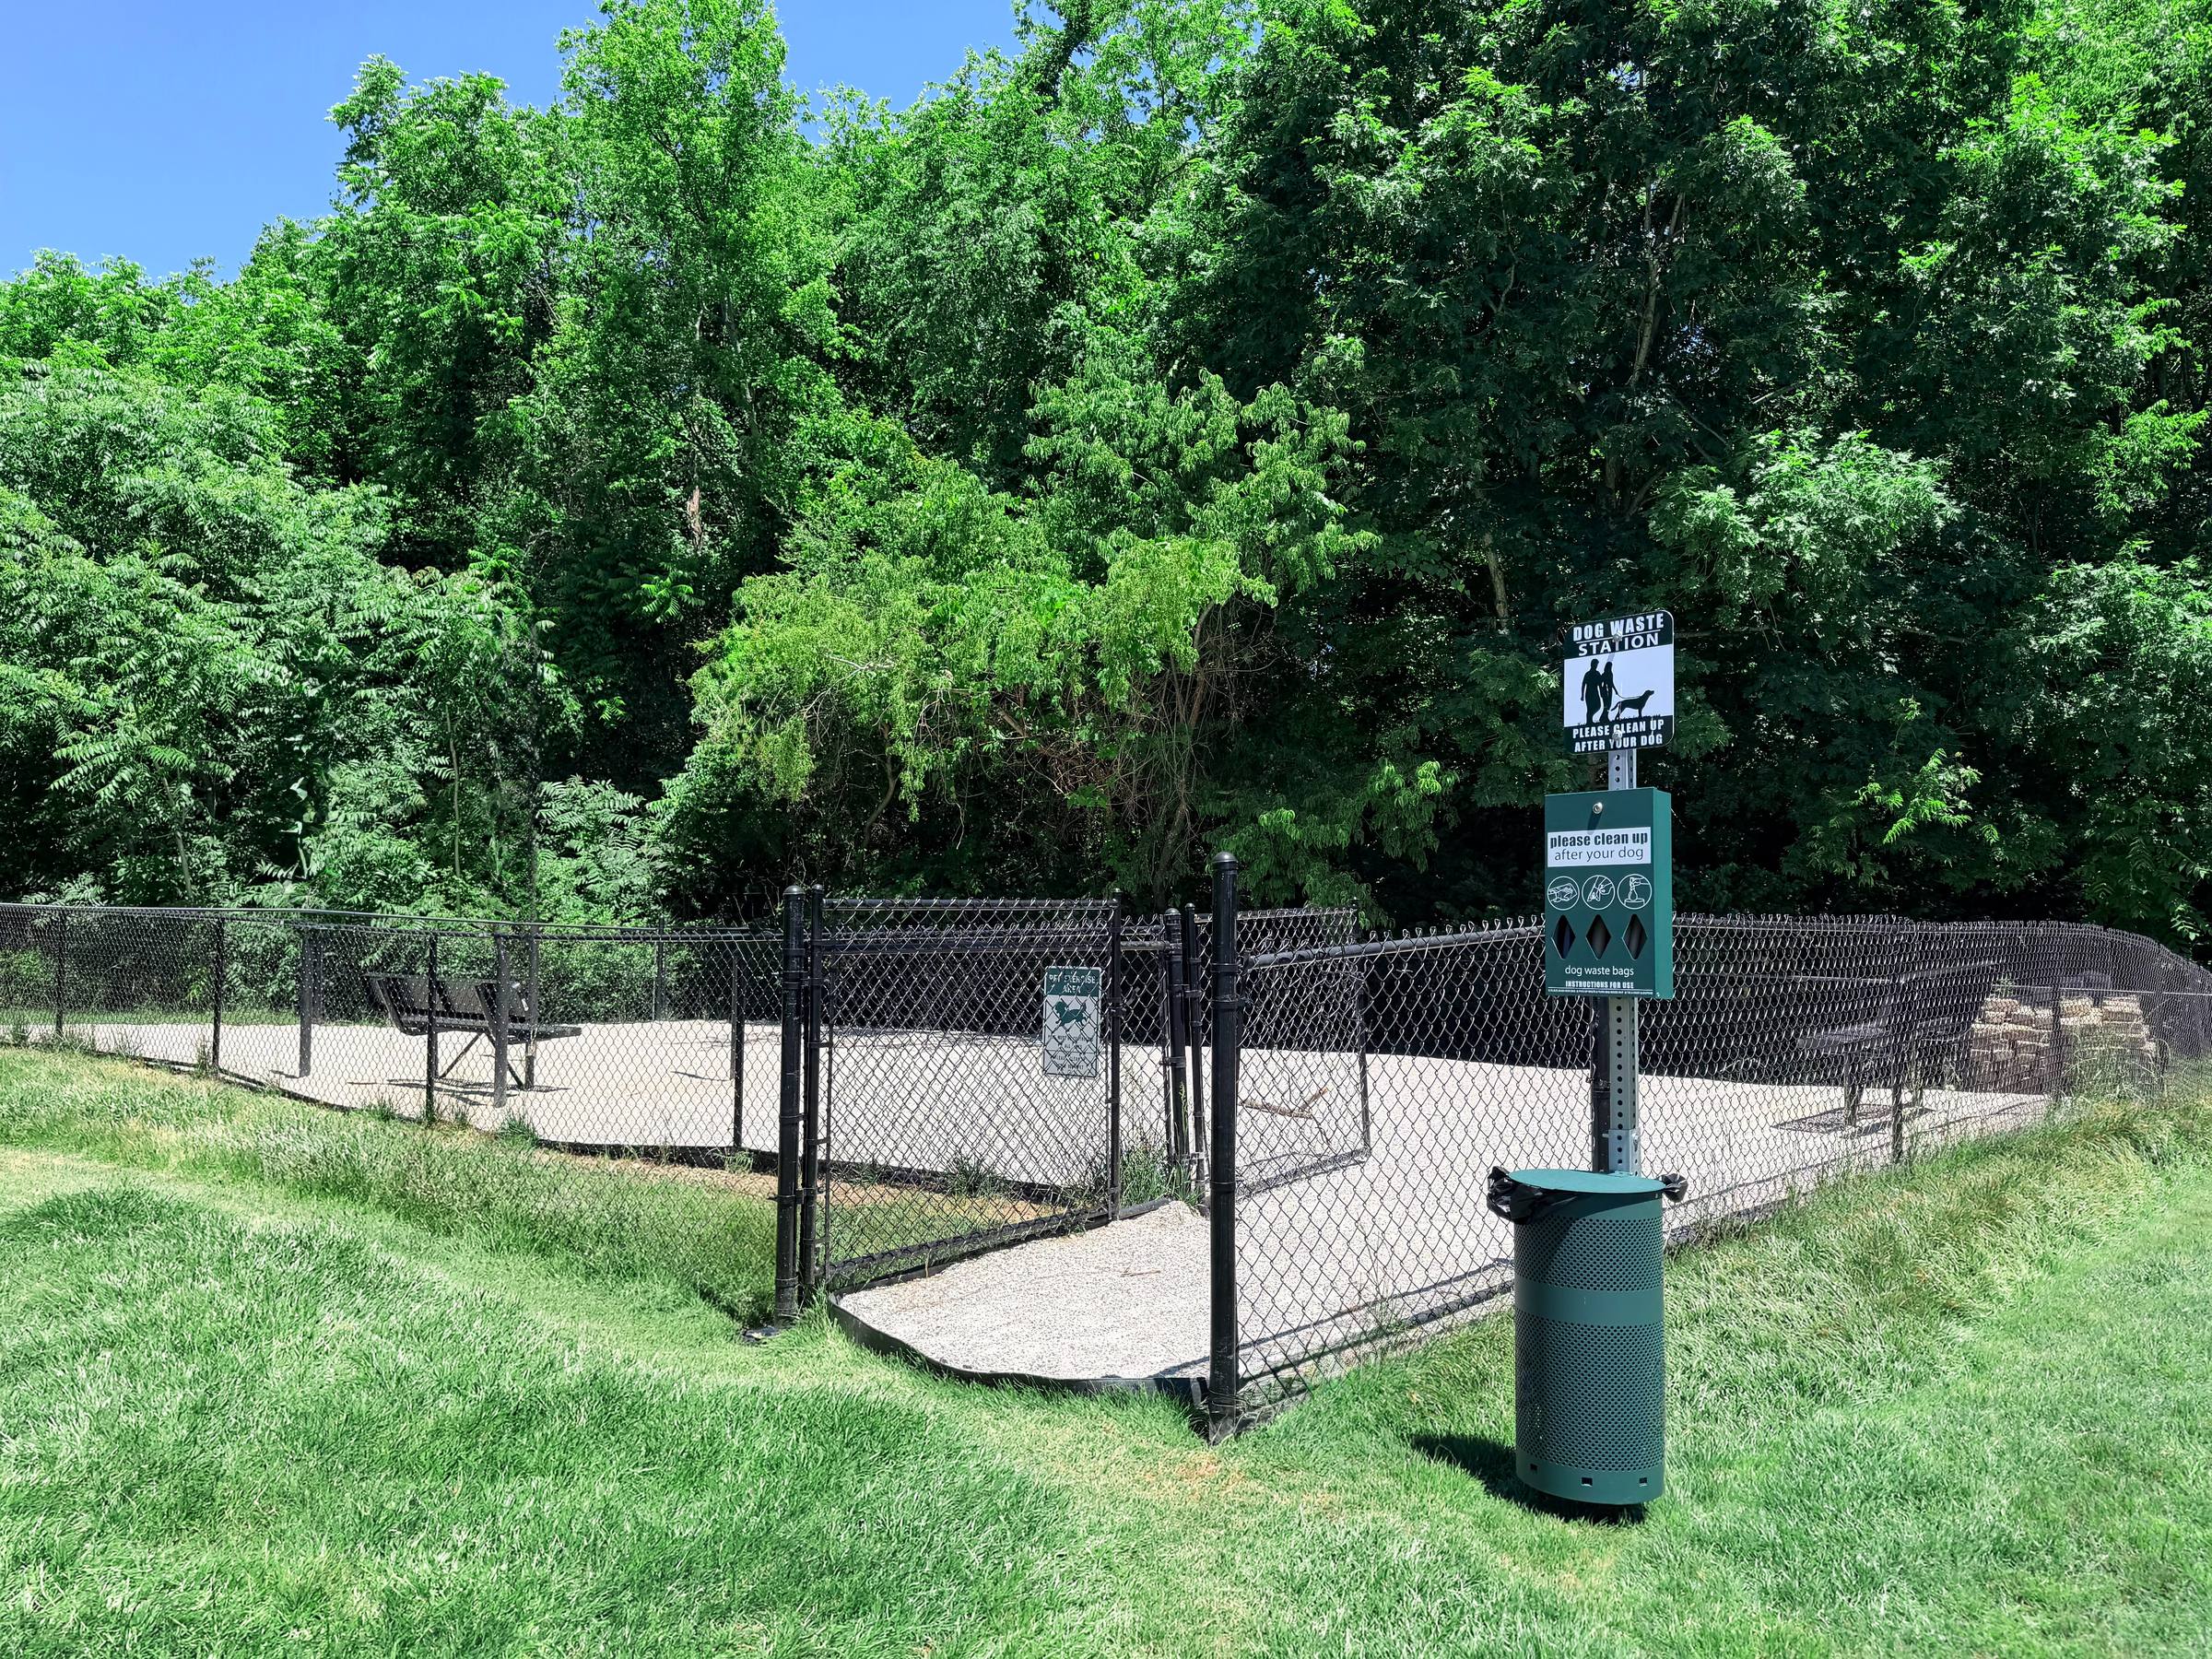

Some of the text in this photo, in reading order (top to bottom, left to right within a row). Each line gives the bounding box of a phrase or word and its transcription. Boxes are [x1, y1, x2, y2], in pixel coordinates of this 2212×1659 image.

[1573, 613, 1664, 641] DOG WASTE
[1578, 632, 1659, 656] STATION
[1572, 719, 1664, 739] PLEASE CLEAN UP
[1574, 734, 1663, 752] AFTER YOUR DOG
[1550, 831, 1648, 849] please clean up
[1554, 845, 1643, 862] after your dog
[1565, 965, 1634, 978] dog waste bags
[1565, 980, 1608, 988] INSTRUCTIONS
